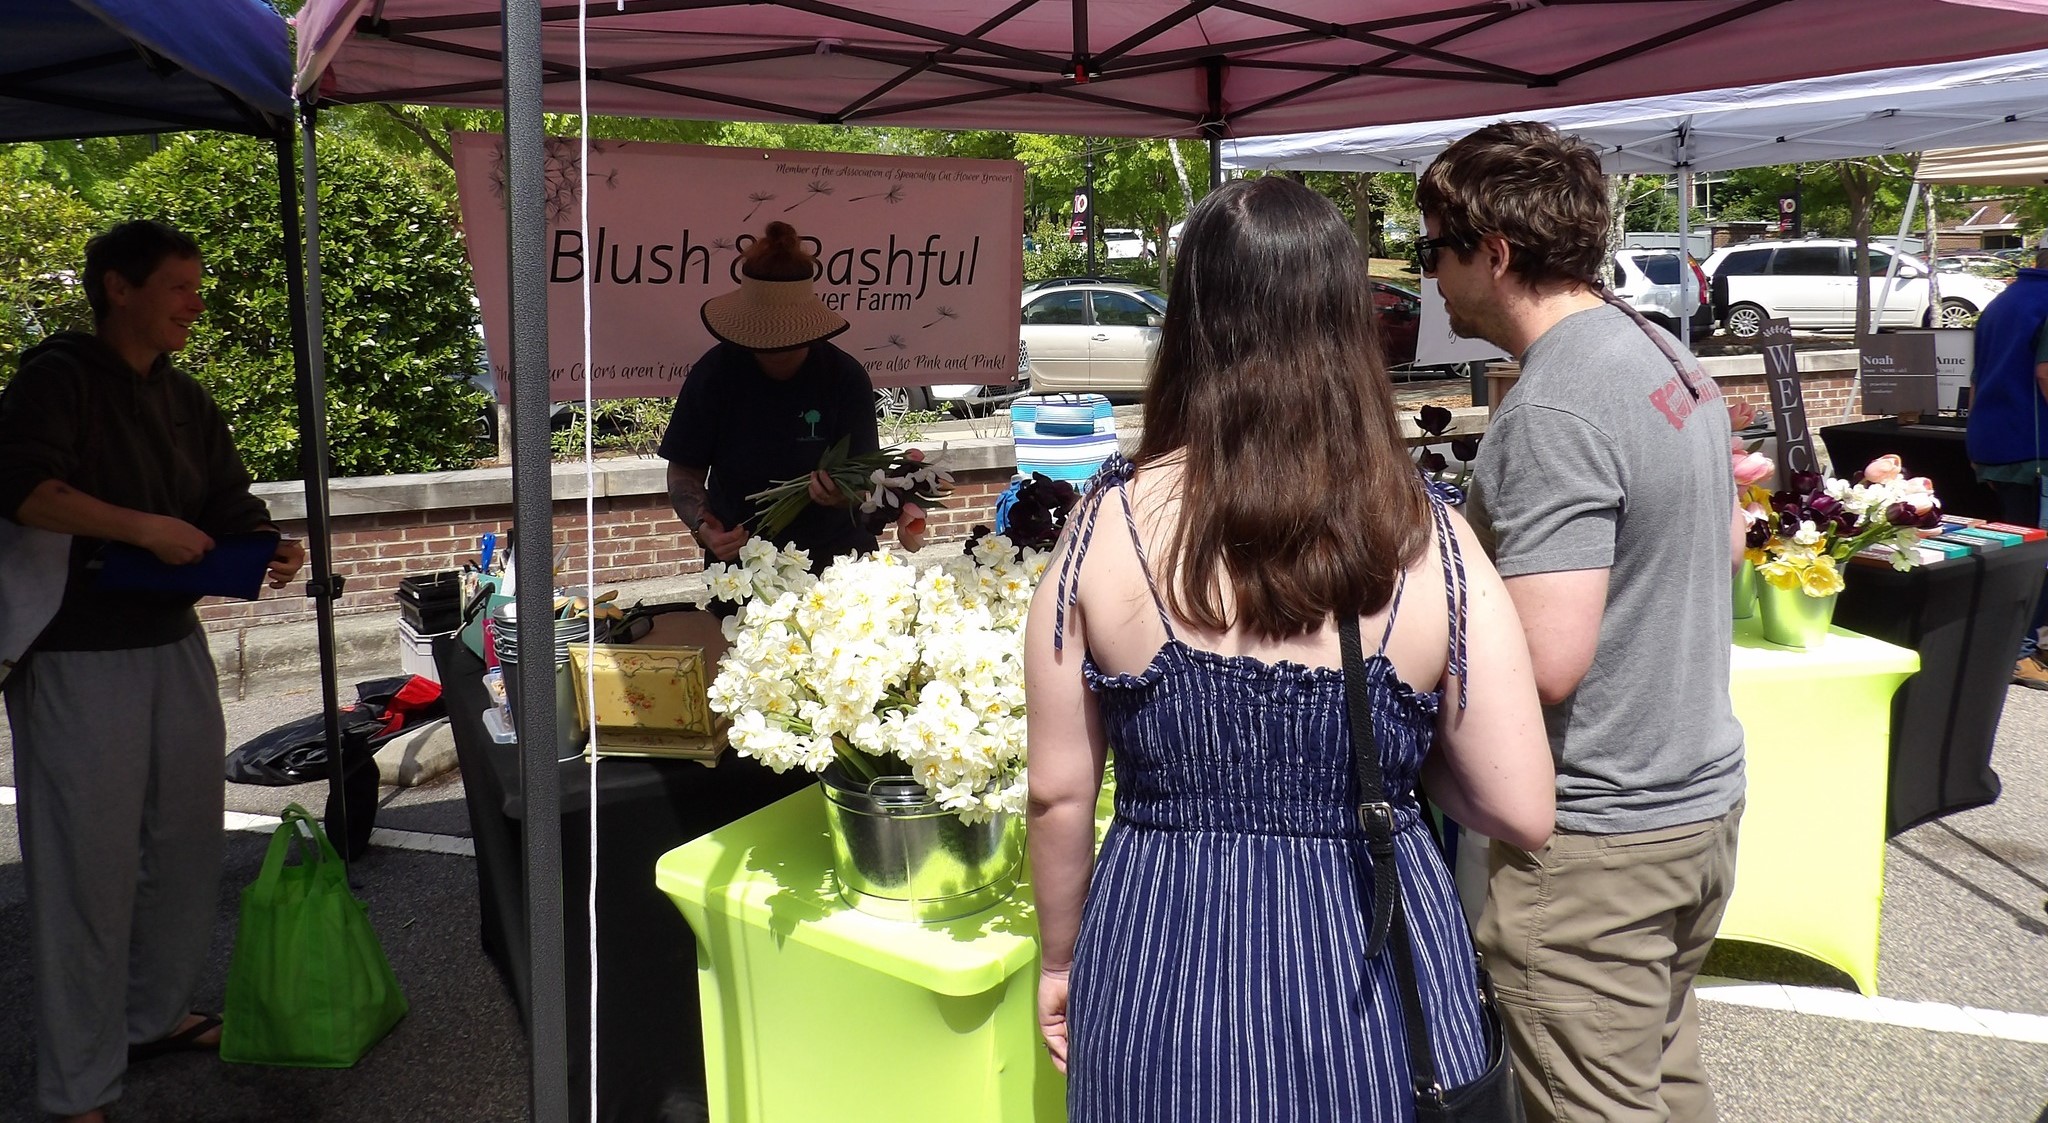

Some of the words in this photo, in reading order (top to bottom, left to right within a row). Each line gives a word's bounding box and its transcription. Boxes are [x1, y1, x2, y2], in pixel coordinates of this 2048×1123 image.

[776, 163, 810, 175] Member
[811, 165, 821, 178] of
[822, 166, 834, 176] the
[836, 166, 883, 178] Association
[885, 168, 895, 180] of
[938, 171, 952, 181] Cut
[954, 172, 980, 183] Flower
[550, 226, 711, 285] Blush
[797, 233, 980, 300] Bashful
[856, 287, 912, 311] Farm
[863, 360, 883, 373] are
[886, 355, 911, 372] also
[913, 354, 941, 370] Pink
[944, 354, 968, 370] and
[971, 354, 1006, 368] Pink!
[1862, 355, 1894, 365] Noah
[570, 362, 616, 382] Colors
[621, 361, 665, 379] aren't
[667, 362, 694, 382] jus
